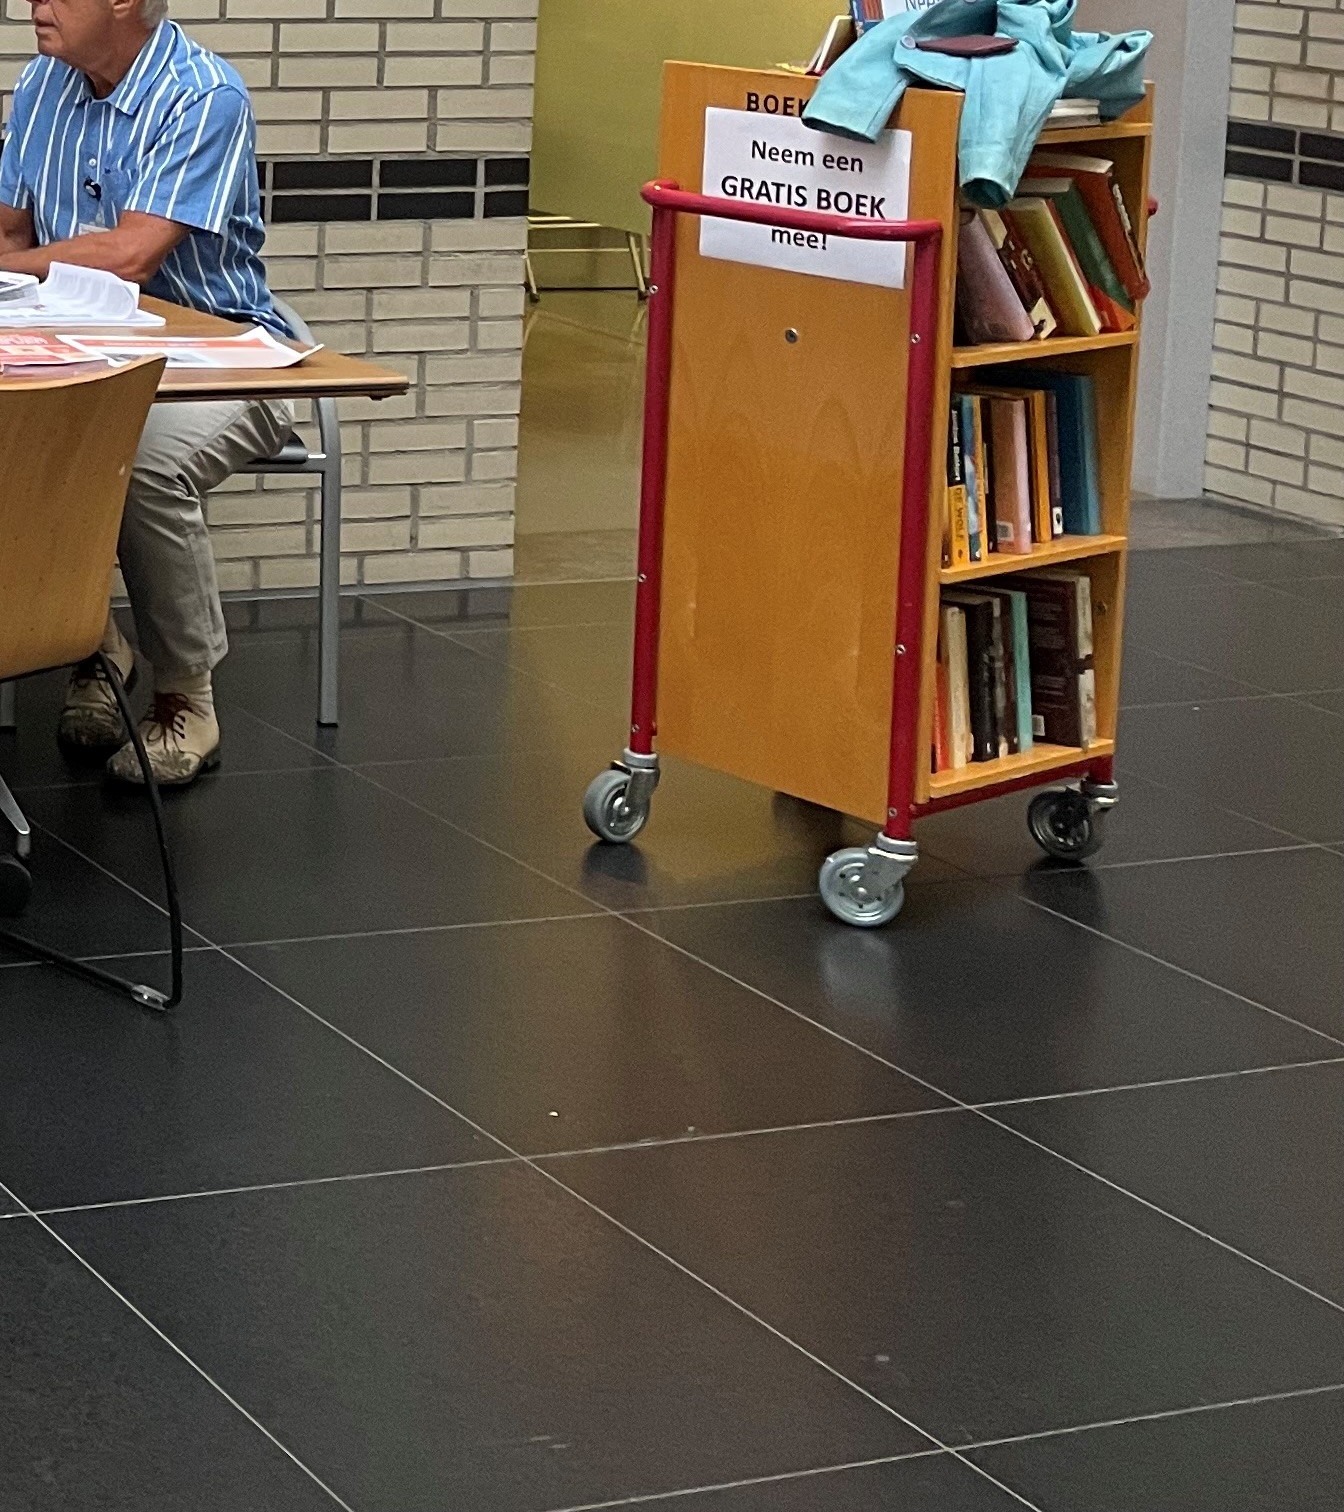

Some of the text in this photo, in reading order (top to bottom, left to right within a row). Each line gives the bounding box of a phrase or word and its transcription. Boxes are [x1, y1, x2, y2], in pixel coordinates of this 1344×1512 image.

[750, 140, 863, 173] Neem een
[721, 175, 886, 219] GRATIS BOEK
[771, 228, 827, 251] mee!
